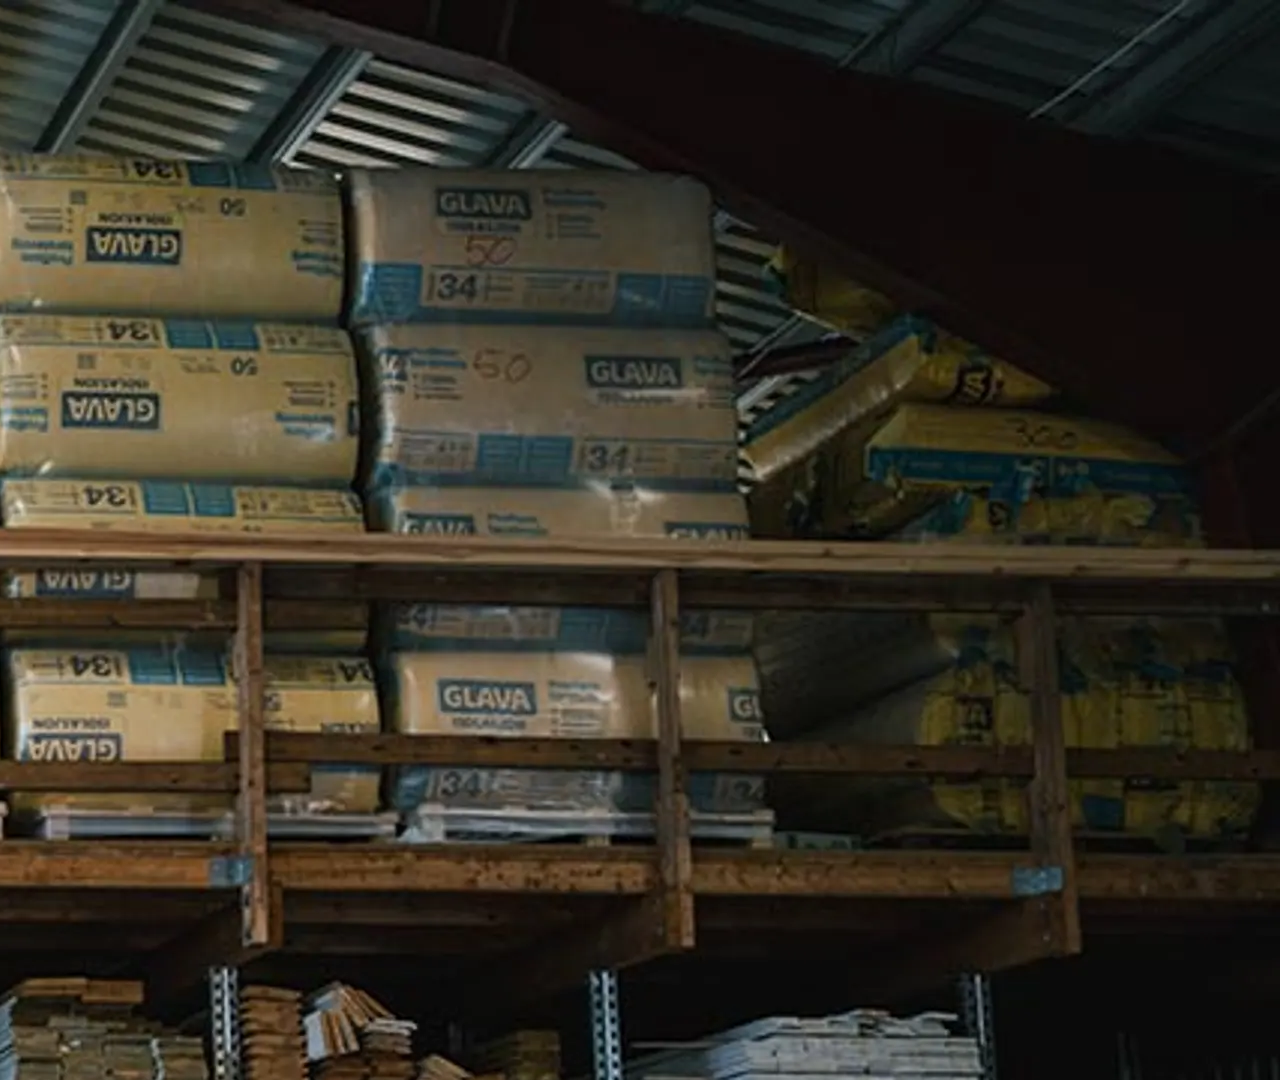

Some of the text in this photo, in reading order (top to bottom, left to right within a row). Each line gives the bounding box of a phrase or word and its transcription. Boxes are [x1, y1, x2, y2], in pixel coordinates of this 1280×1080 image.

[440, 192, 529, 217] GLAVA
[93, 231, 178, 257] GLAVA
[437, 272, 478, 300] 34
[107, 320, 152, 341] 34
[473, 348, 533, 385] 50
[591, 360, 679, 386] GLAVA
[68, 397, 156, 422] GLAVA
[588, 445, 631, 471] 34
[84, 484, 127, 507] 34
[71, 654, 112, 677] 34
[443, 685, 532, 711] GLAVA
[27, 739, 119, 762] GLAVA
[442, 770, 482, 797] 34
